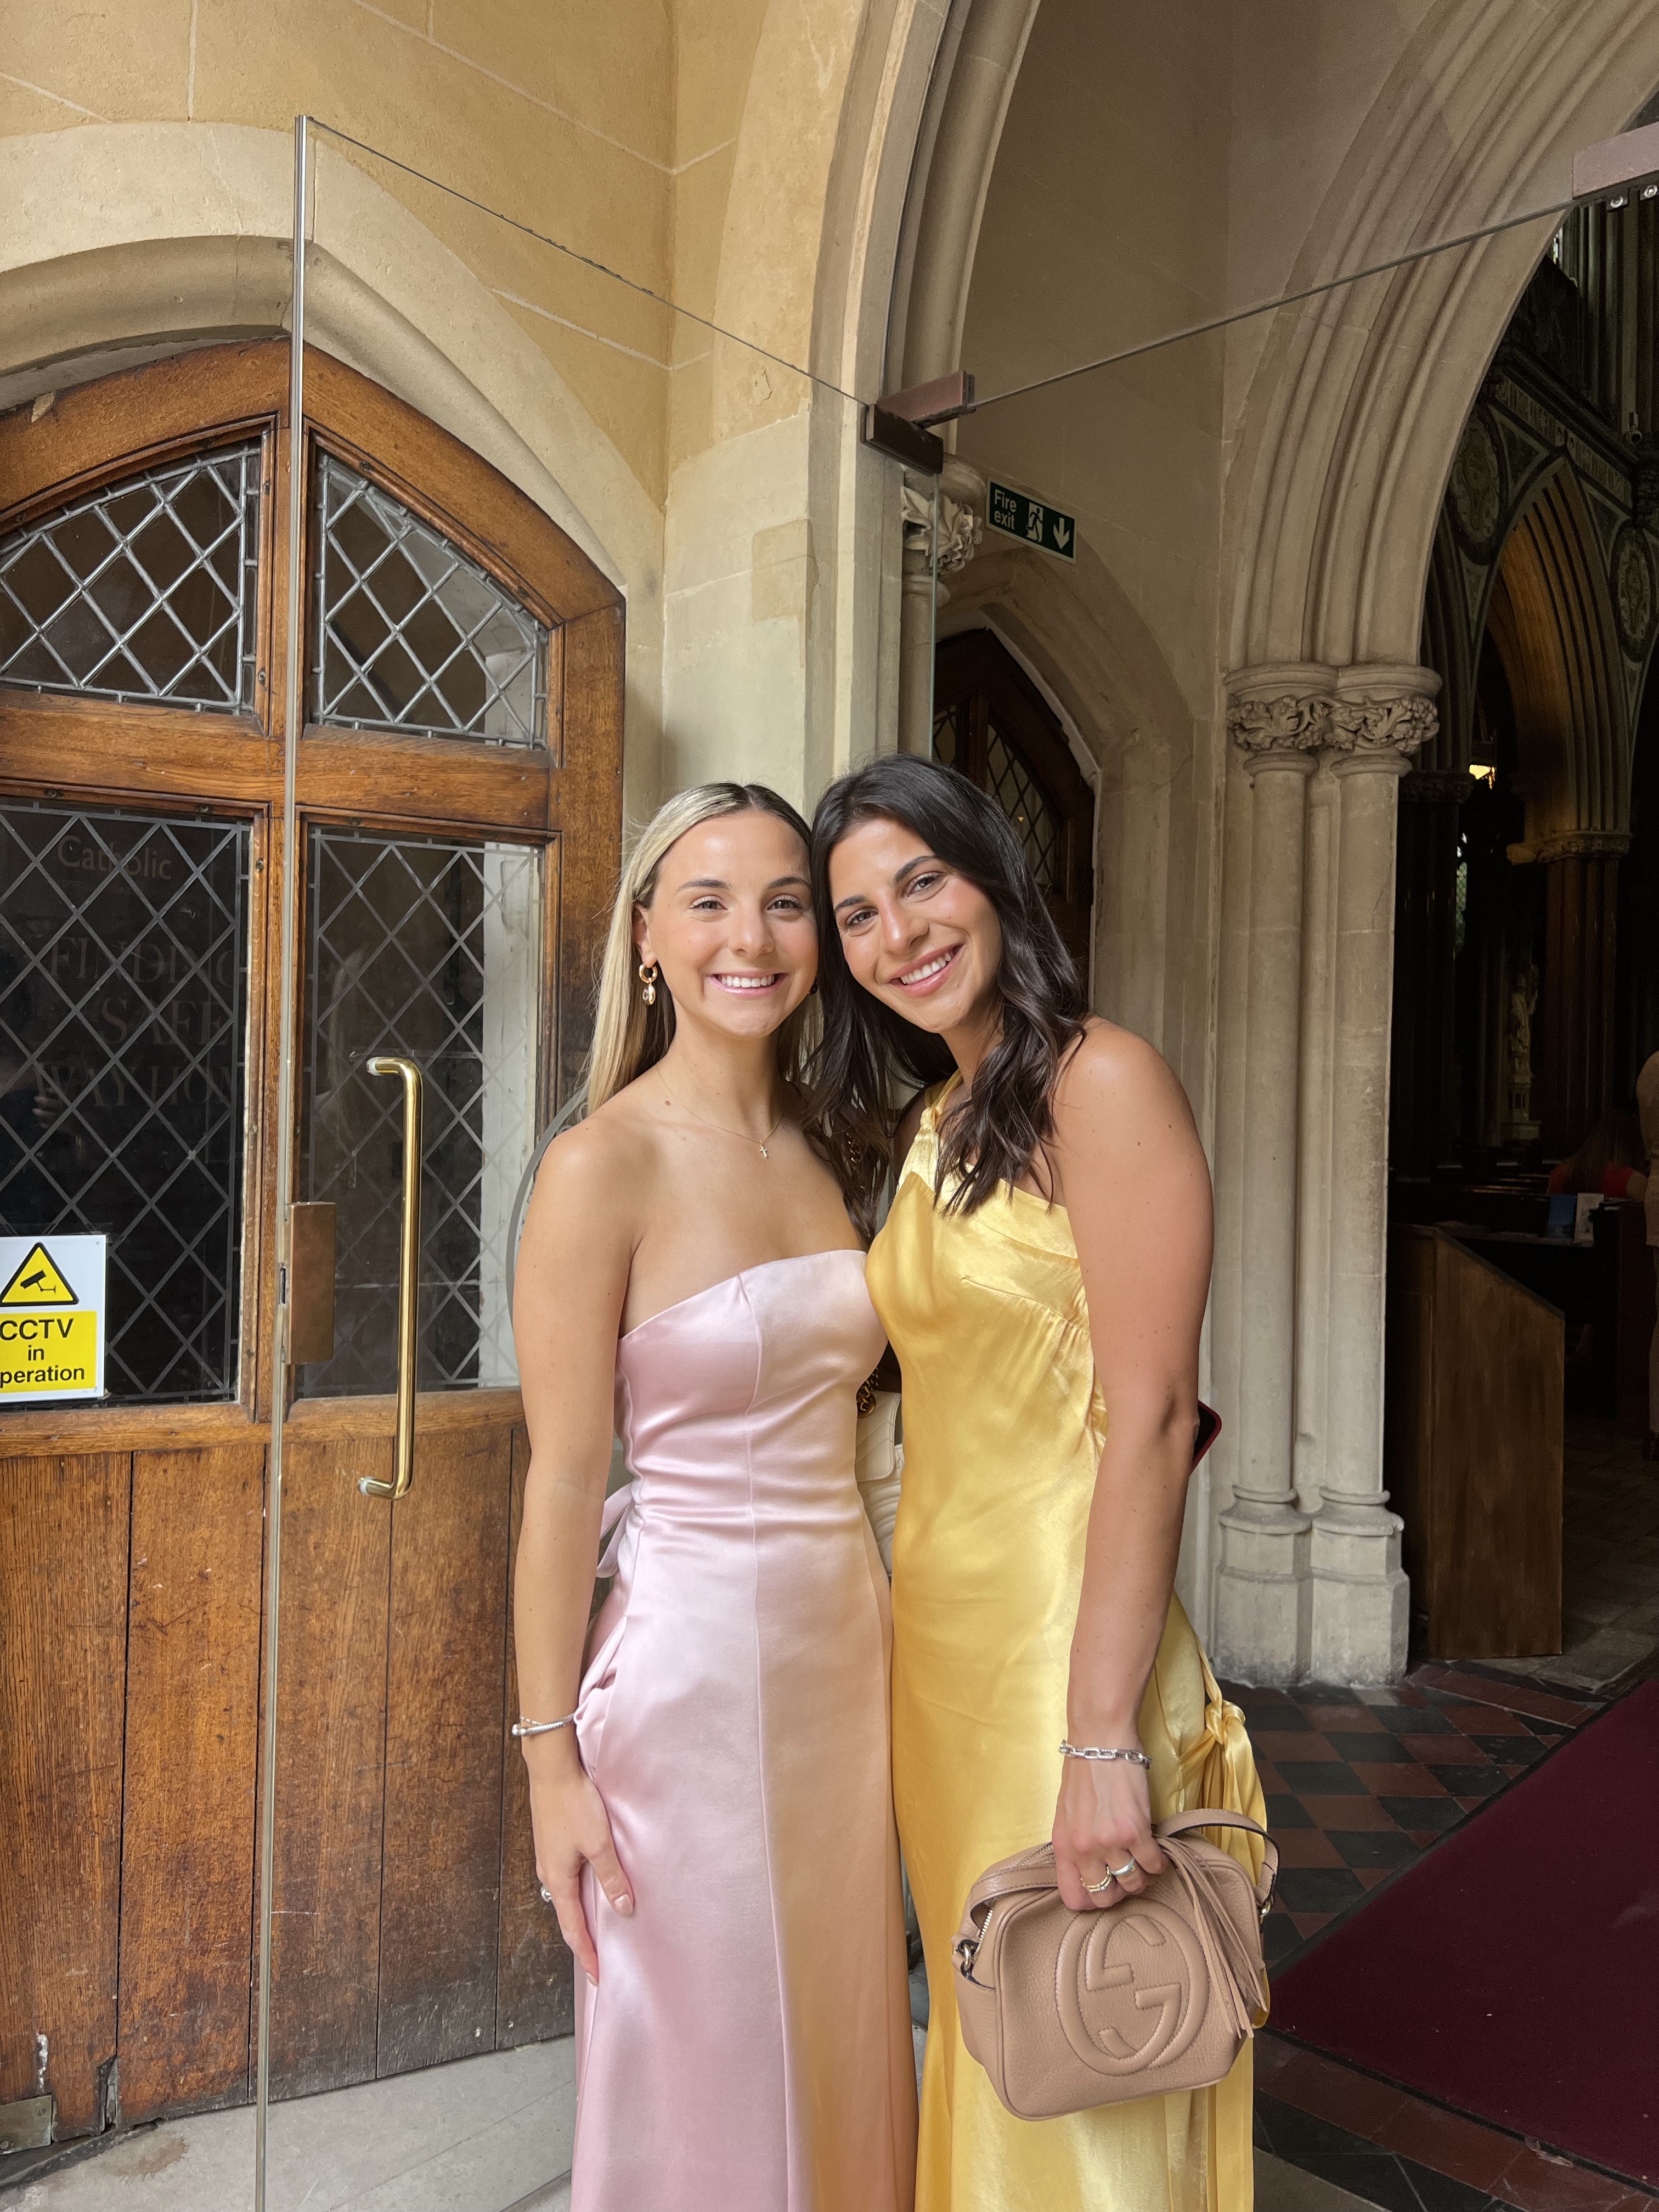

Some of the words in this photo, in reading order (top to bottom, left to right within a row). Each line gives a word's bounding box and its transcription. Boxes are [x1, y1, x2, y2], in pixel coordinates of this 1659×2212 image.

[994, 489, 1017, 512] Fire
[994, 510, 1015, 530] exit
[57, 834, 172, 880] Catholic
[0, 1318, 74, 1341] CCTV
[27, 1345, 44, 1361] in
